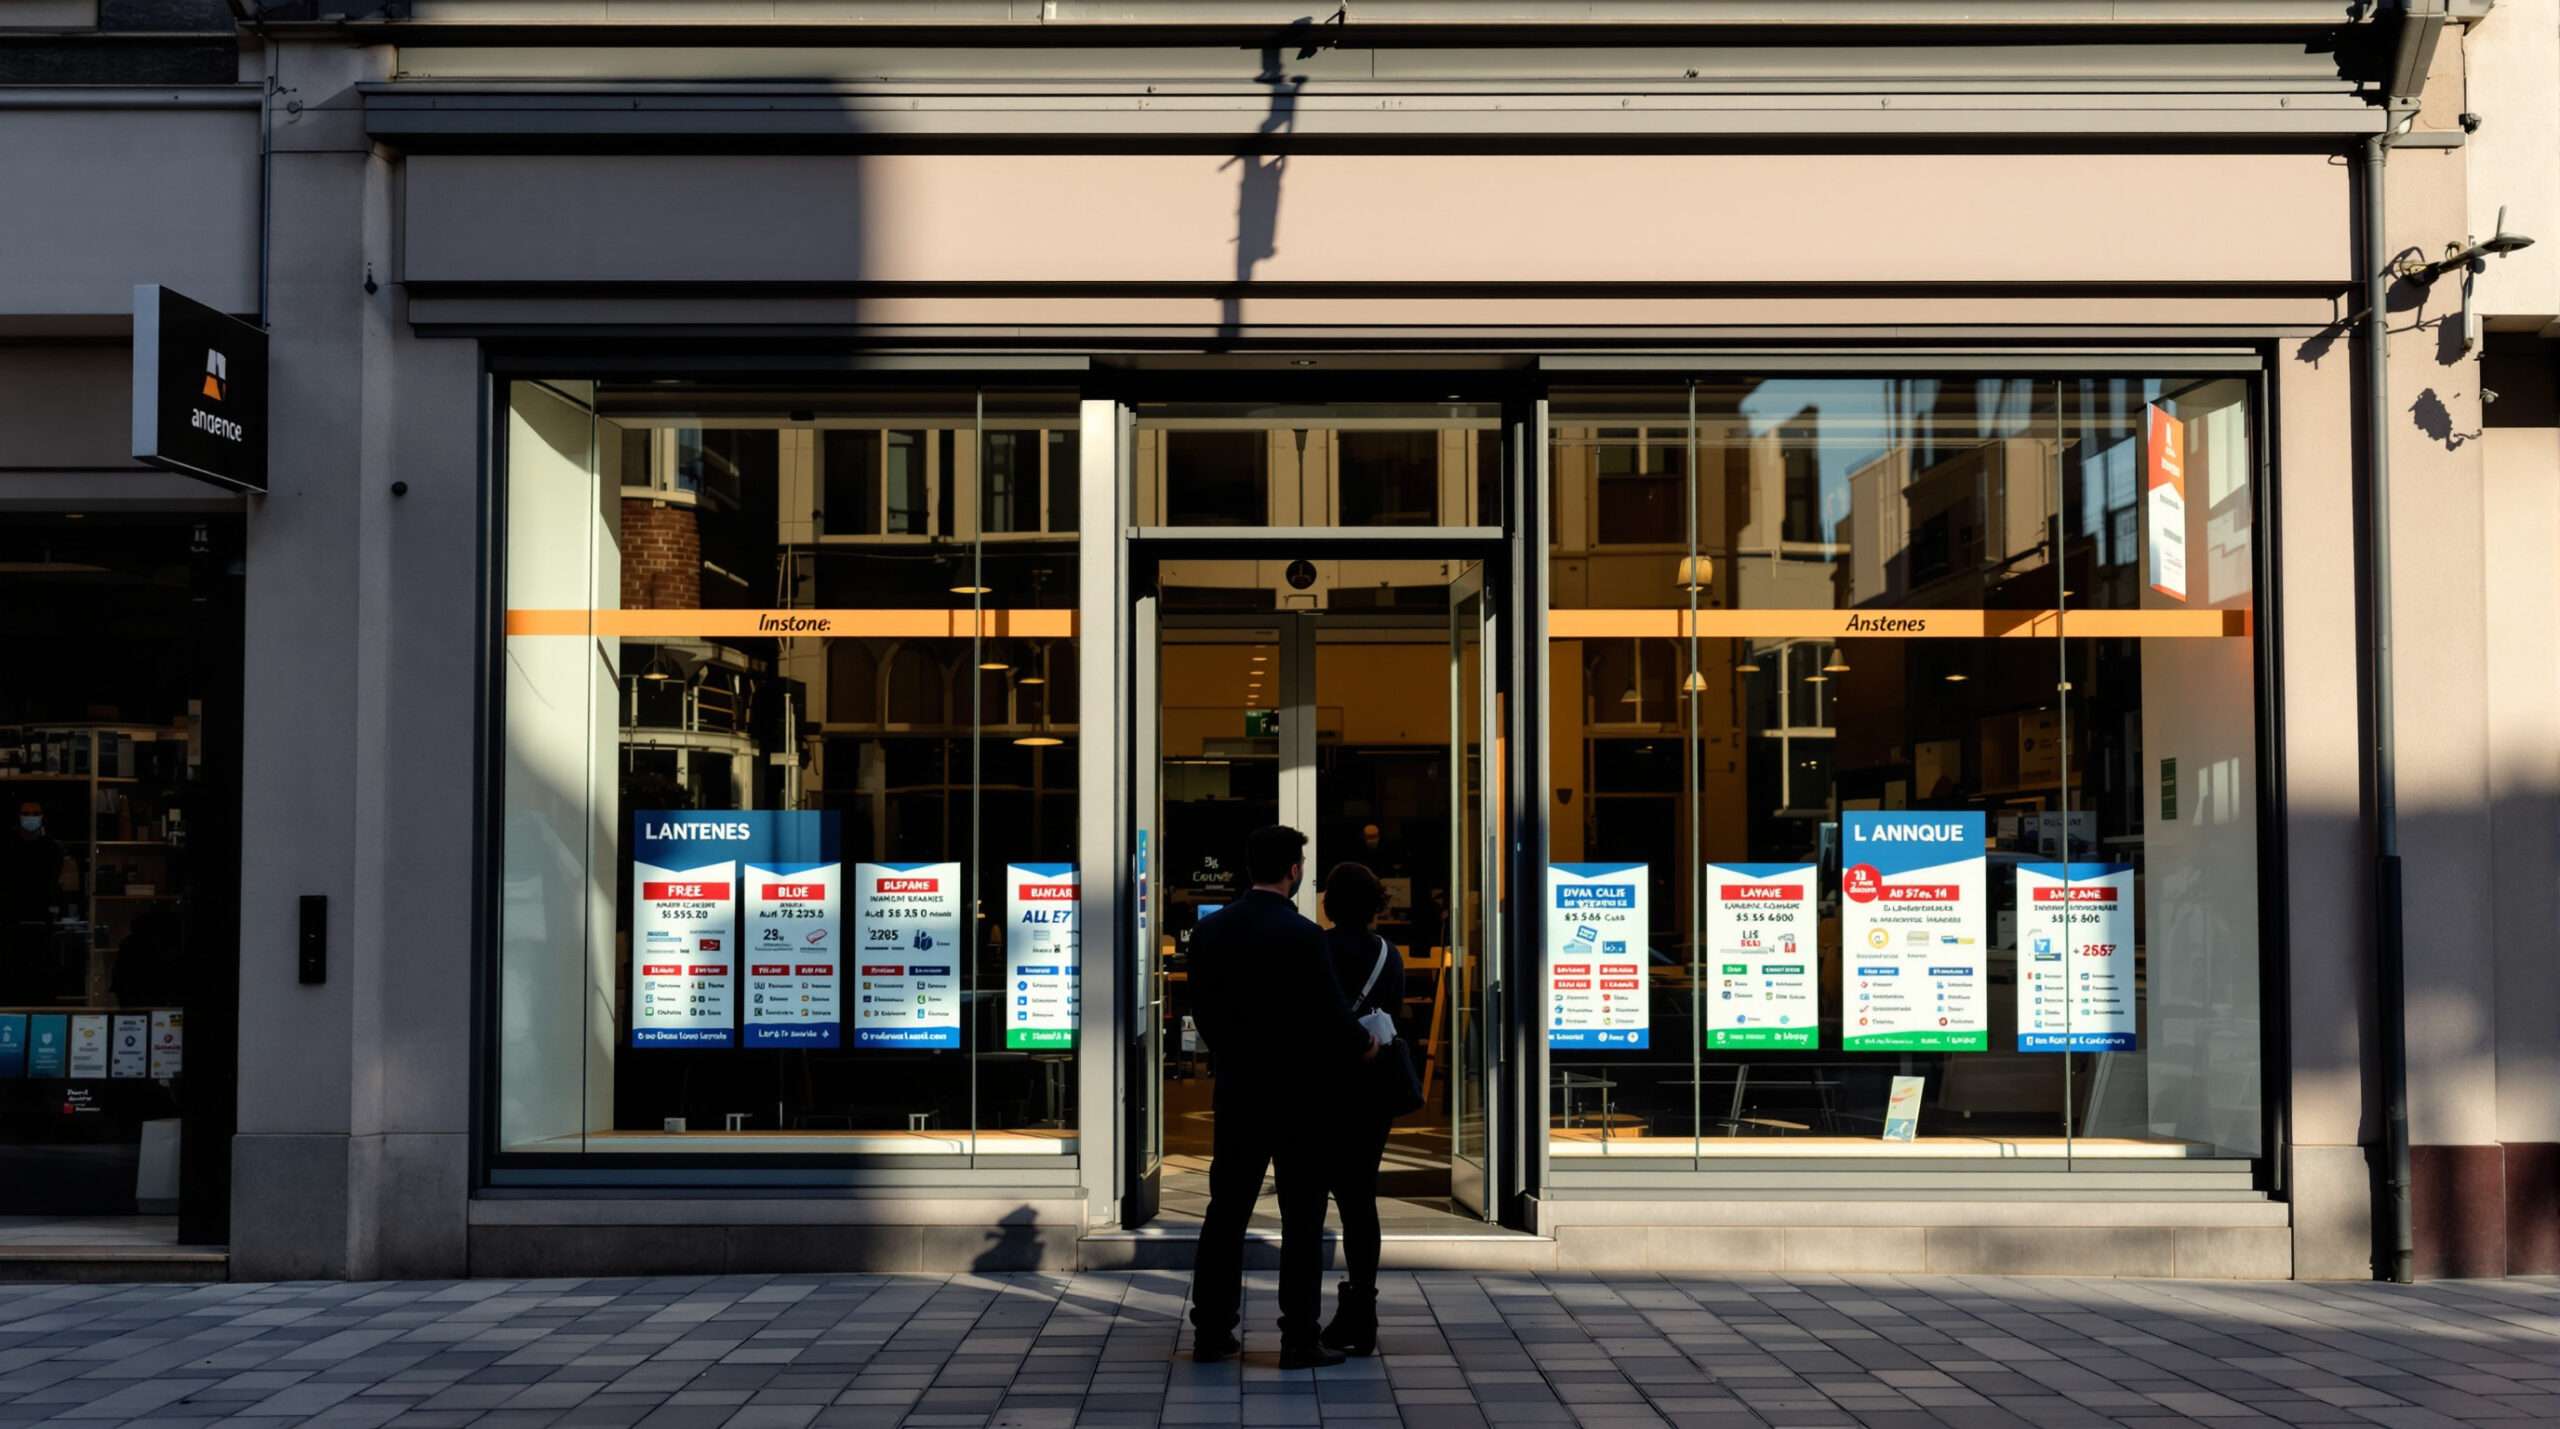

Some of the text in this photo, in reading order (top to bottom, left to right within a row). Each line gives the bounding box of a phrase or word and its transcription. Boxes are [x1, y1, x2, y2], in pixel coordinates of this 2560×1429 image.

[1845, 613, 1926, 632] Anstenes
[645, 822, 751, 841] LANTENES
[1871, 824, 1964, 842] ANNQUE
